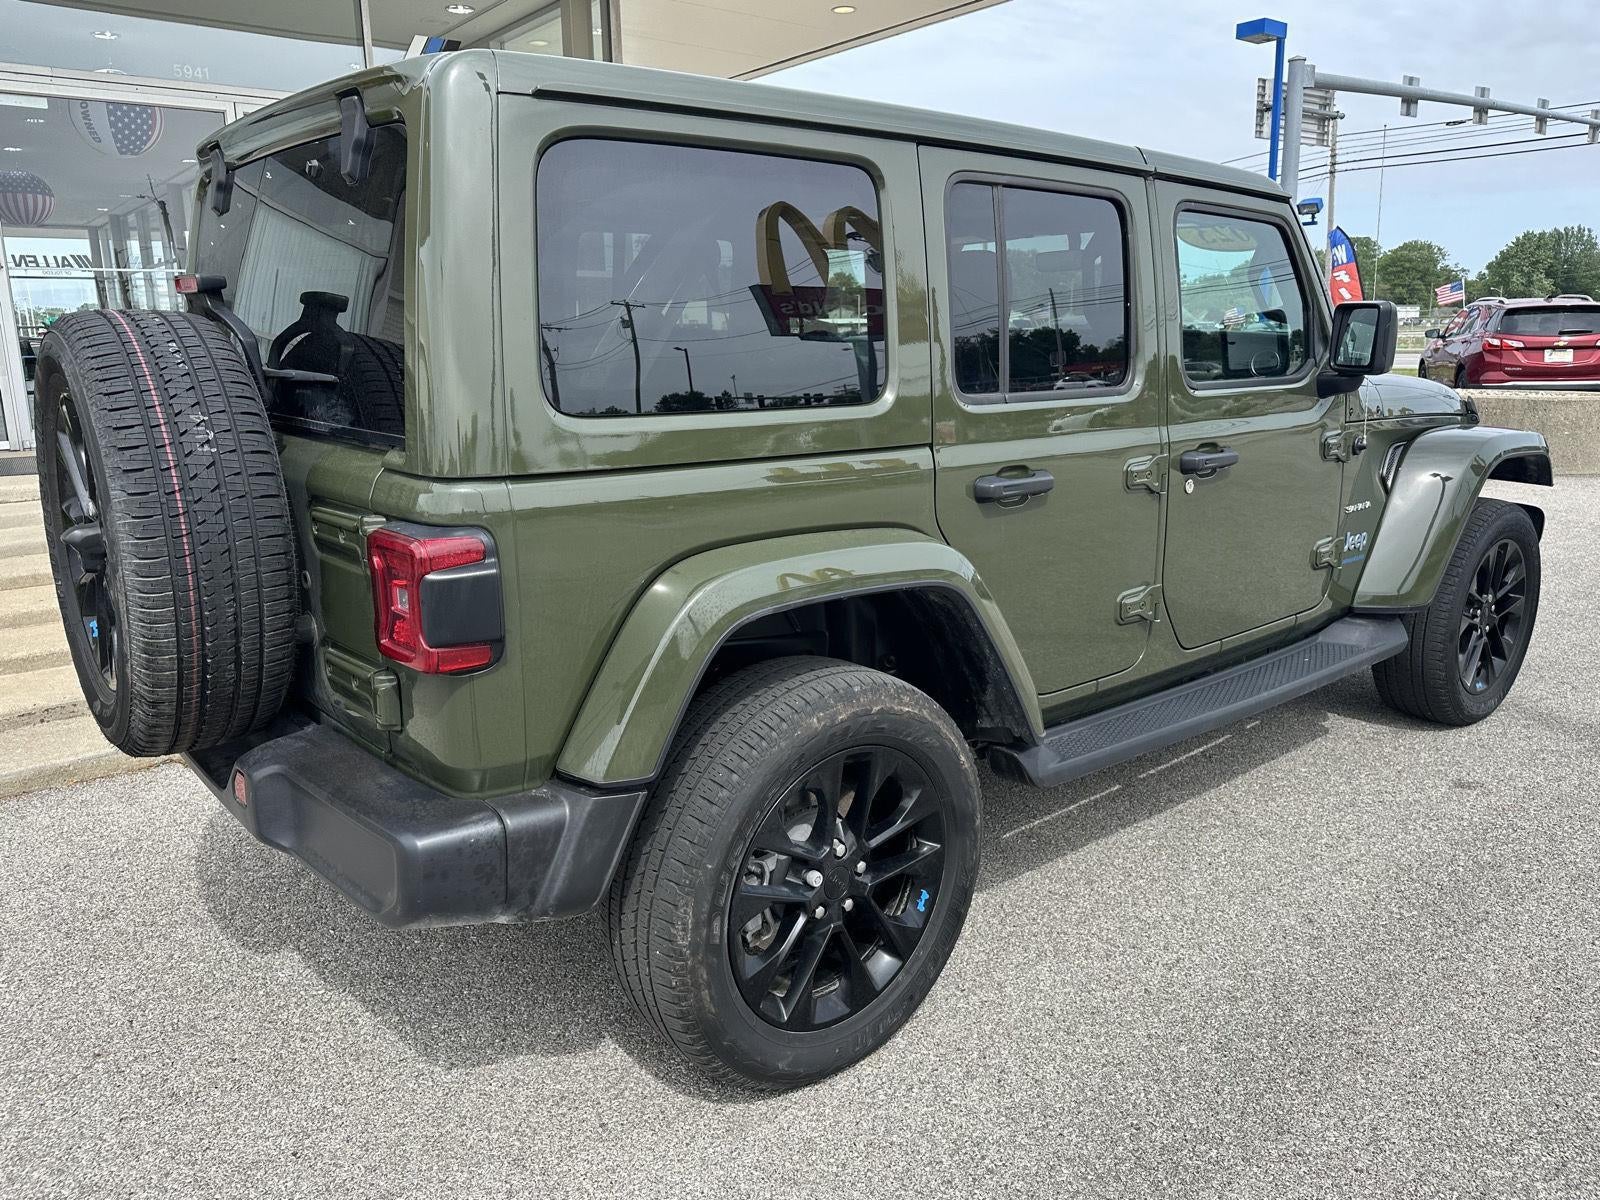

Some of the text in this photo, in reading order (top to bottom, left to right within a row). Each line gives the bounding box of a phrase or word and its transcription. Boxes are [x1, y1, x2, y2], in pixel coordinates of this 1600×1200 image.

[173, 64, 210, 80] 5941
[79, 100, 102, 144] OWNED
[1343, 531, 1367, 552] Jeep
